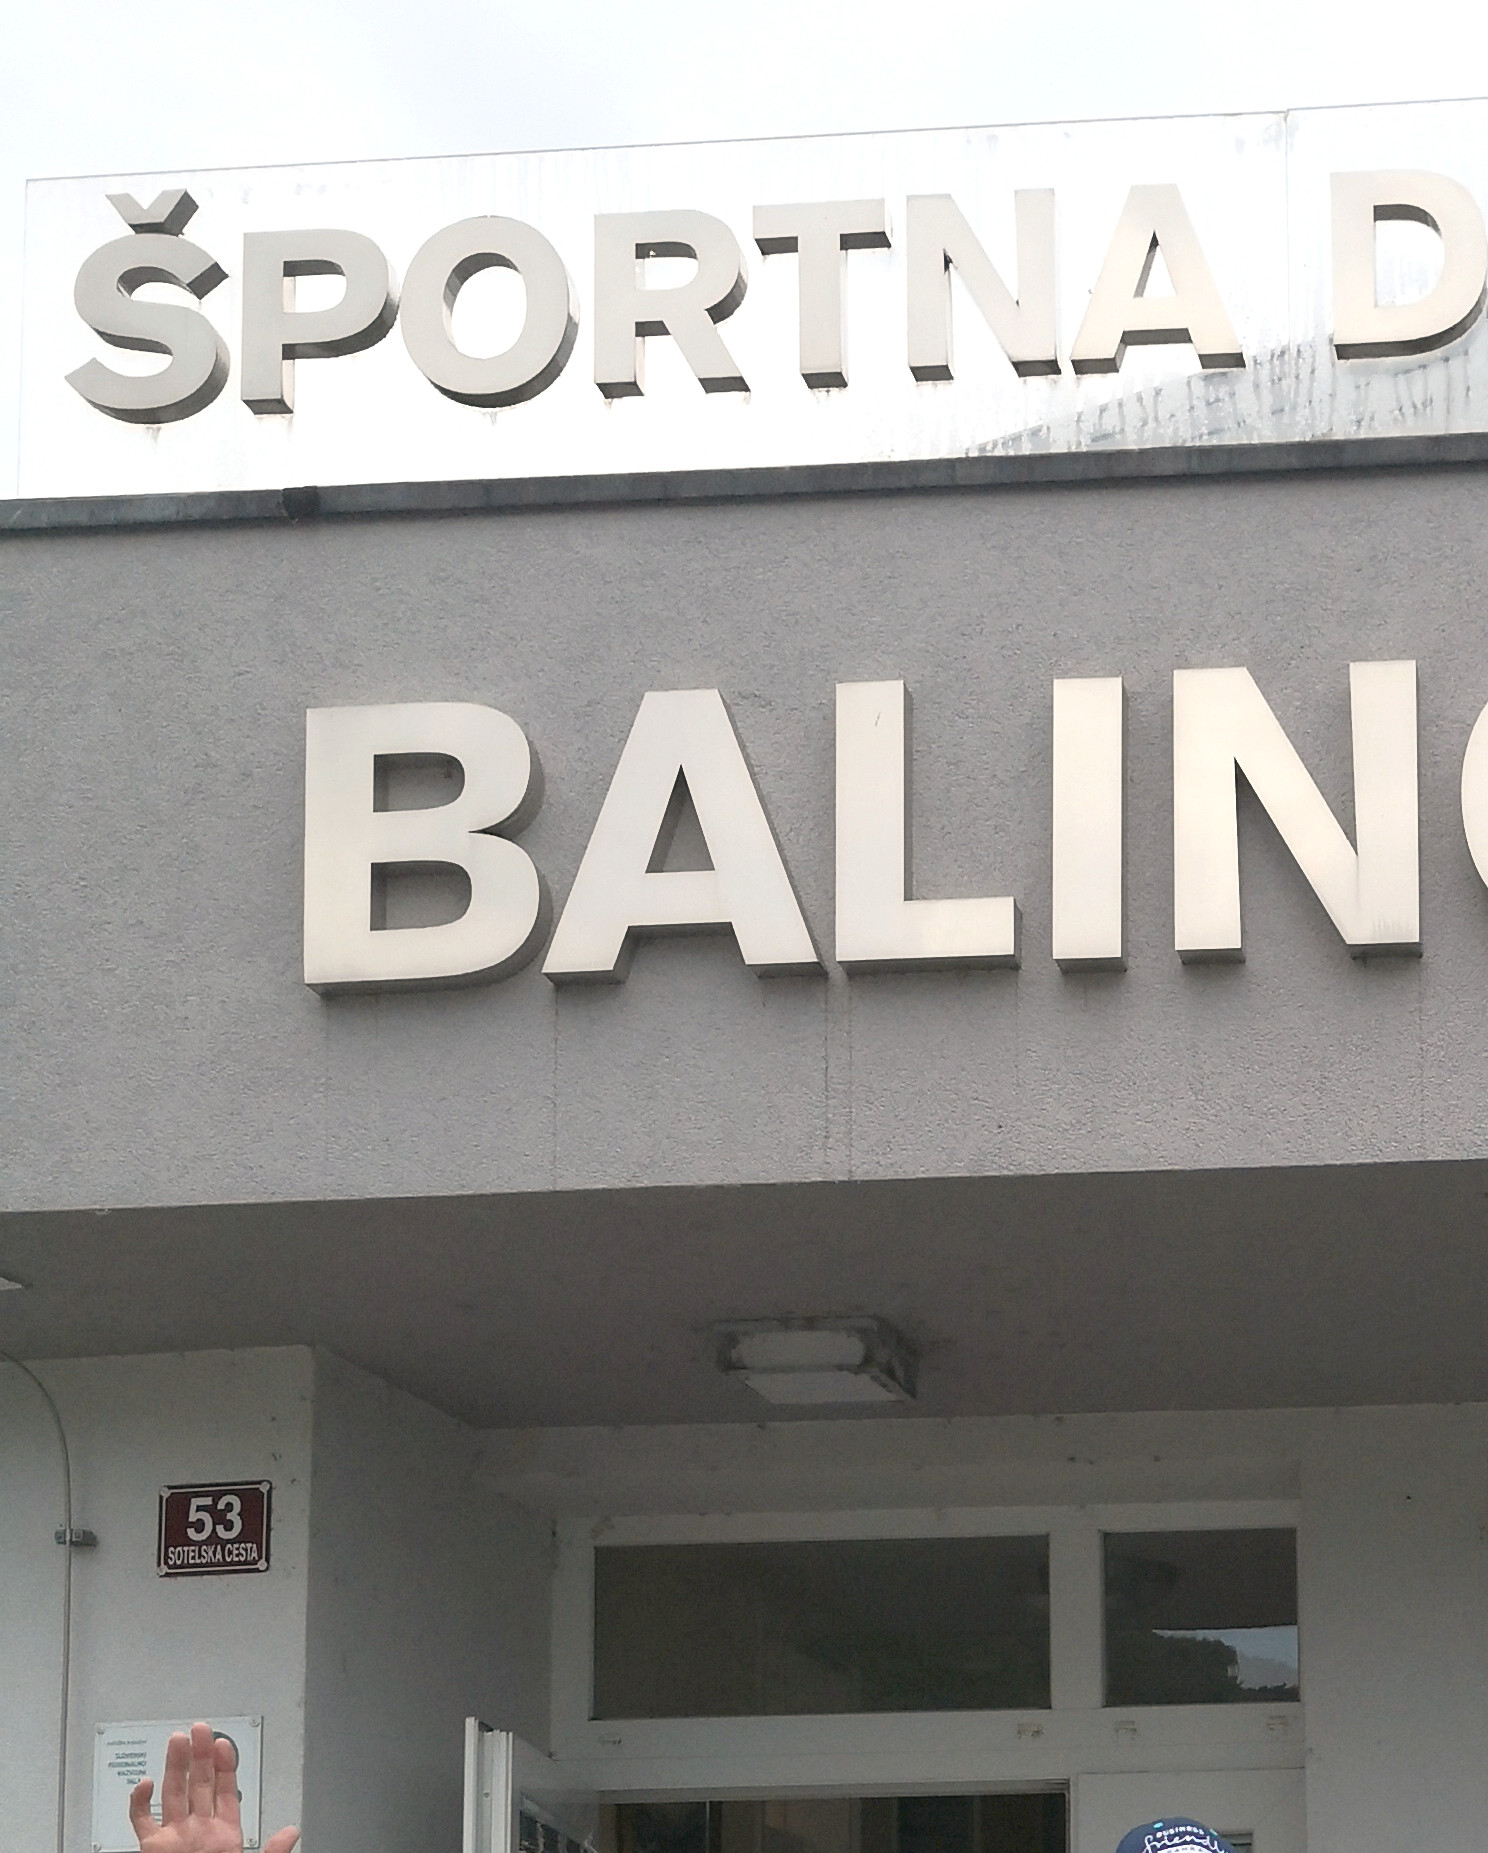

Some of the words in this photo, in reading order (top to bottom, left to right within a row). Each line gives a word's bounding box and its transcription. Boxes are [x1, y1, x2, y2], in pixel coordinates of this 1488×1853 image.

[64, 186, 1245, 424] ŠPORTNA
[186, 1494, 243, 1542] 53
[167, 1544, 223, 1565] SOTELSKA
[224, 1542, 259, 1562] CESTA
